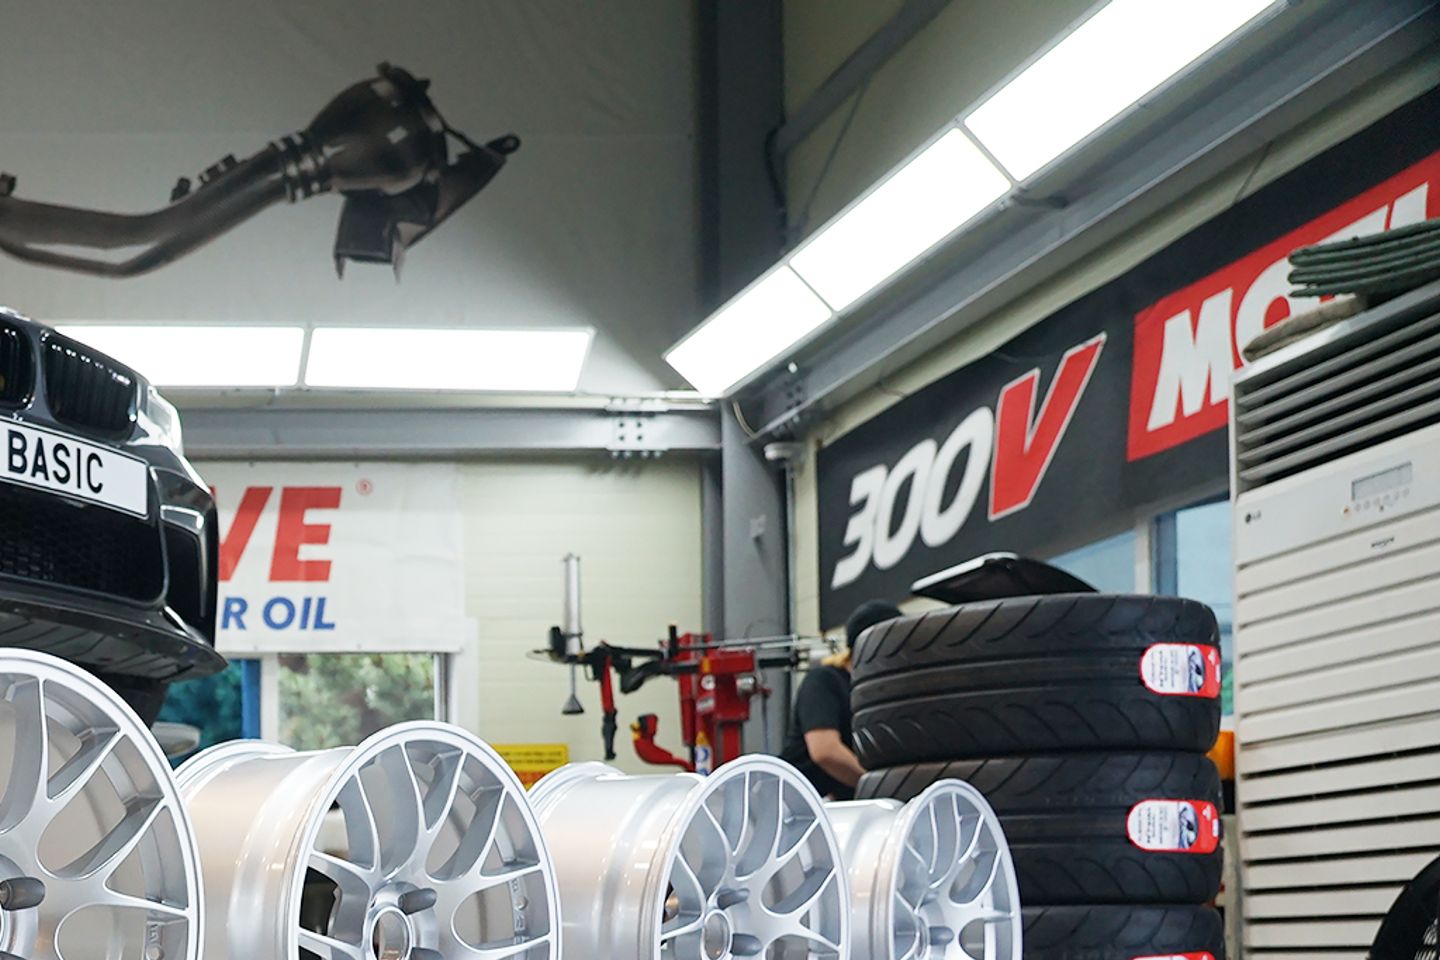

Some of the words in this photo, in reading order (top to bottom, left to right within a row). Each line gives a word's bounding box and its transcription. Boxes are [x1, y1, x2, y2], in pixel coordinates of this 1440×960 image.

[7, 429, 103, 493] BASIC
[831, 331, 1107, 590] 300V
[263, 597, 335, 630] OIL
